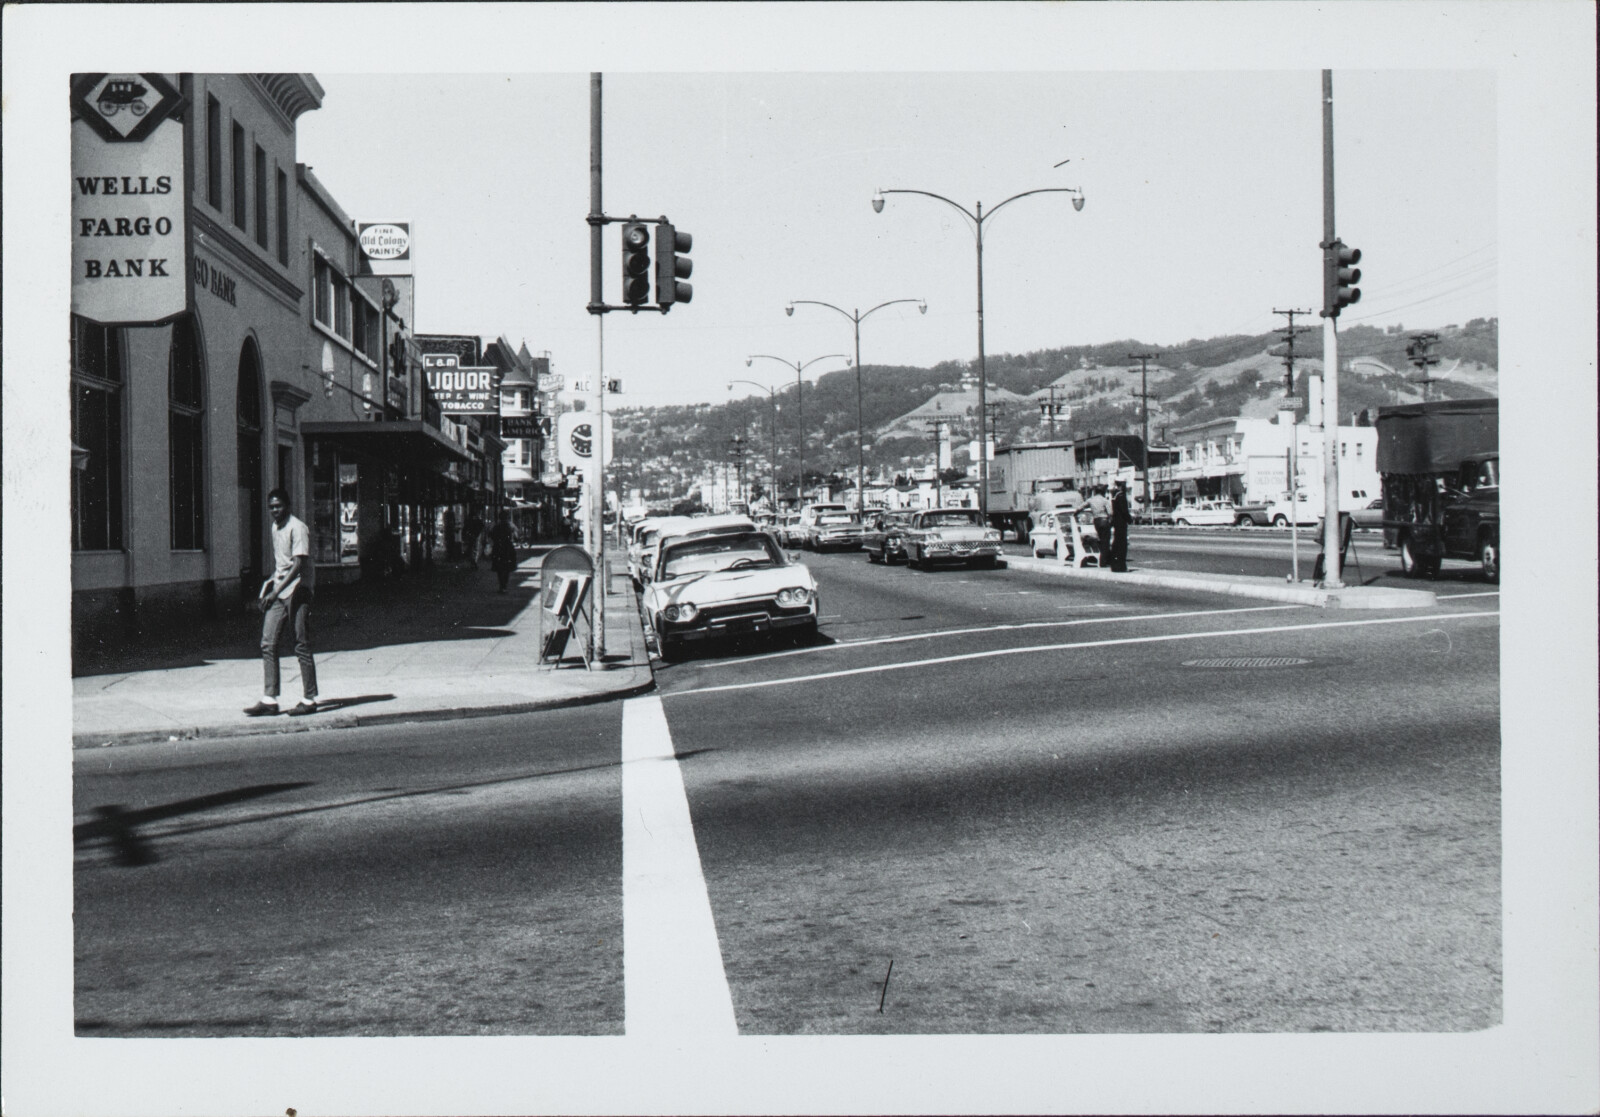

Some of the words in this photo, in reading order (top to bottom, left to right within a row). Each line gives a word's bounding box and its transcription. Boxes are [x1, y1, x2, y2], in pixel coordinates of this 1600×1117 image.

[76, 176, 172, 195] WELLS
[79, 216, 172, 237] FARGO
[361, 236, 376, 246] Old
[378, 235, 407, 248] Colony
[84, 258, 169, 278] BANK
[194, 255, 208, 289] GO
[210, 265, 237, 307] BANK
[426, 372, 491, 392] LIQUOR
[574, 380, 618, 392] ALCRAZ
[434, 392, 451, 400] EER
[456, 392, 464, 400] &
[468, 392, 490, 400] WINE
[442, 402, 485, 410] TOBACCO
[507, 418, 532, 426] BANK
